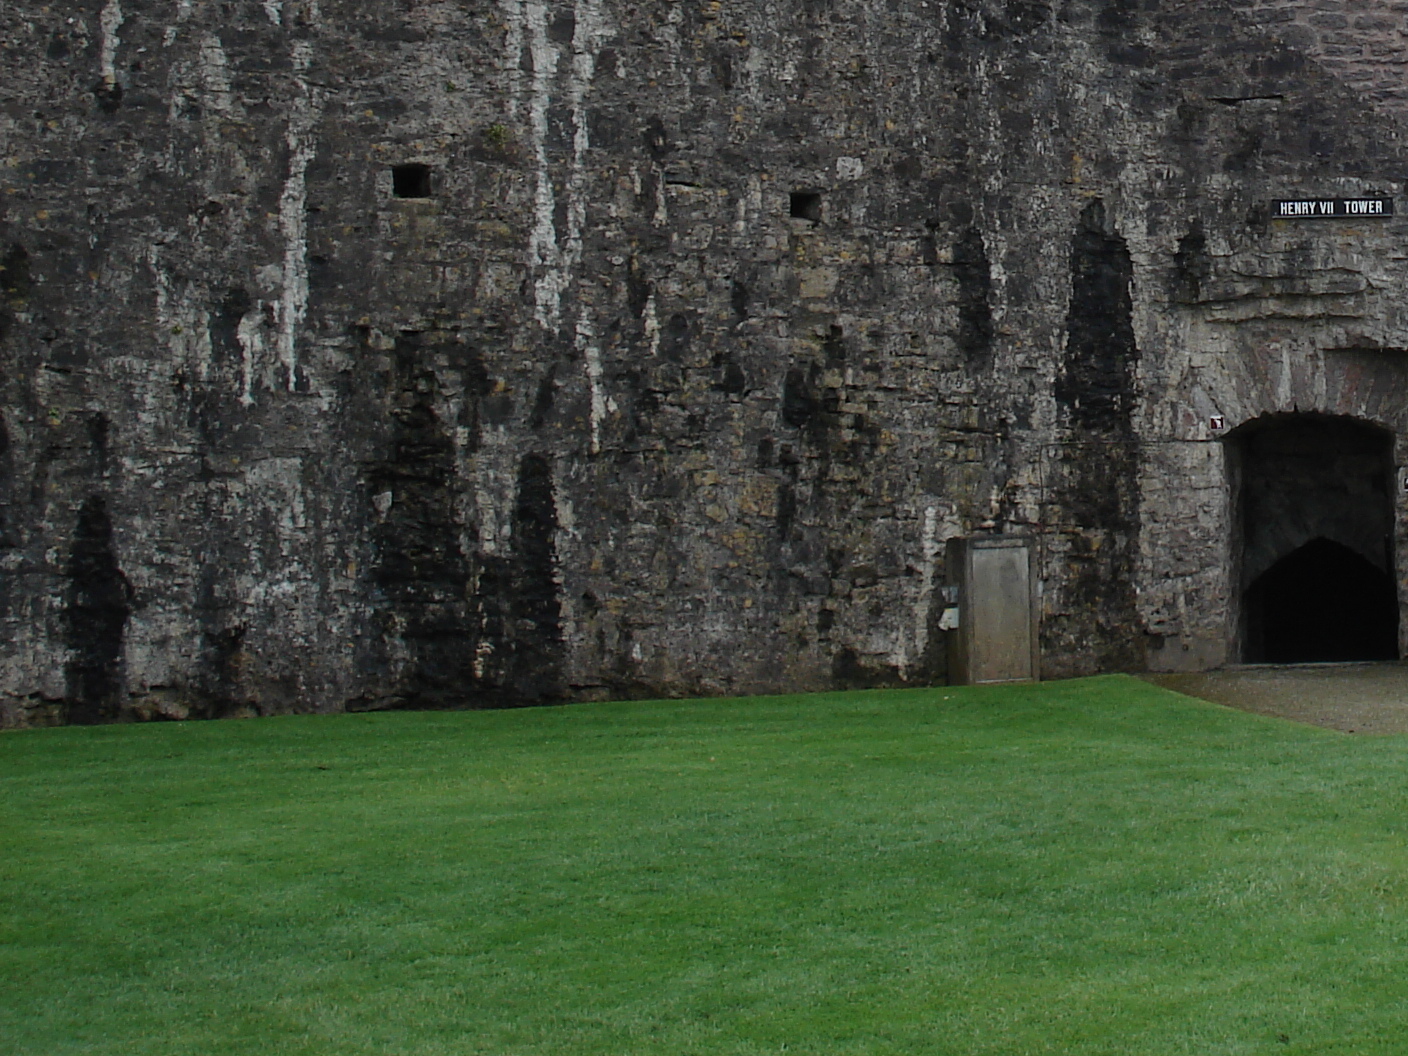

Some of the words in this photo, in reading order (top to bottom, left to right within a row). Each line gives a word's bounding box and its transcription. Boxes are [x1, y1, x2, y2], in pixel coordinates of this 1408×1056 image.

[1280, 202, 1316, 215] HENRY
[1319, 202, 1334, 214] VII
[1344, 201, 1382, 213] TOWER
